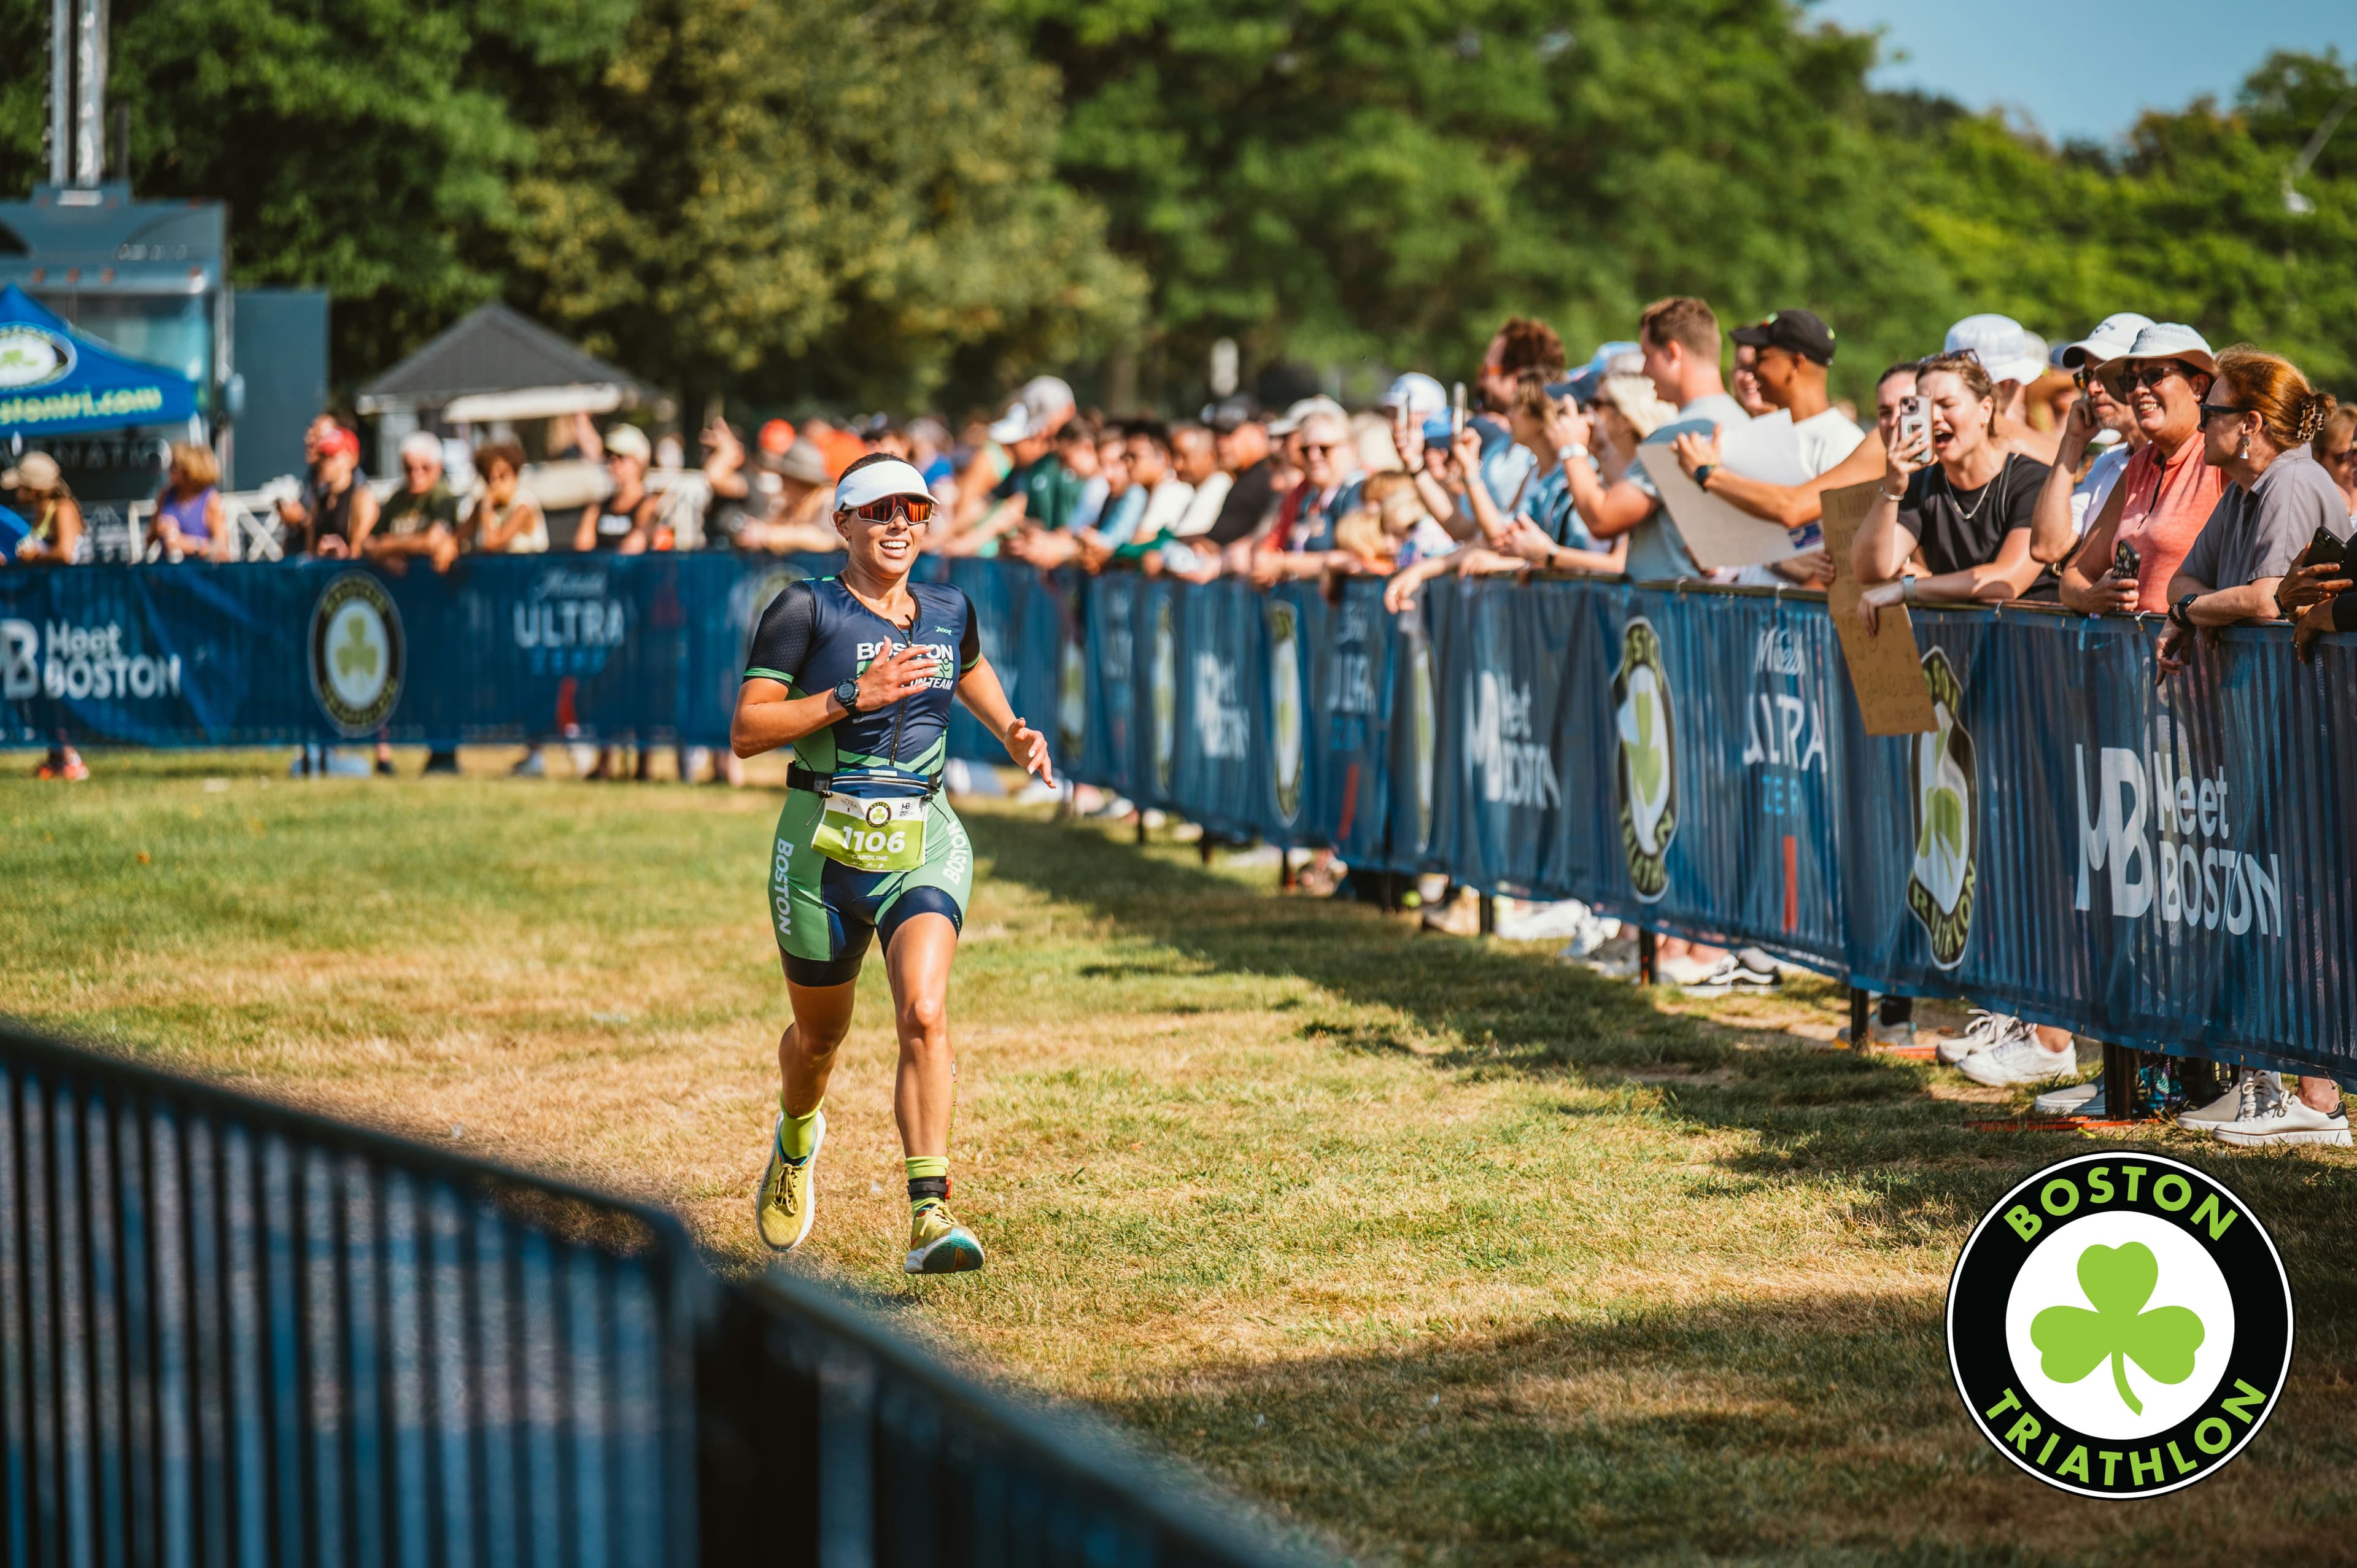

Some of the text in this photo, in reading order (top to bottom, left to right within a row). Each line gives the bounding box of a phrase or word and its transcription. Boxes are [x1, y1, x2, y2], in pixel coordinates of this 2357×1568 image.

[45, 617, 123, 662] Meet
[514, 599, 625, 648] ULTRA
[44, 653, 182, 700] BOSTON
[928, 677, 954, 690] TEAM
[1762, 774, 1801, 816] ZER
[2153, 751, 2230, 840] Meet
[843, 825, 906, 854] 1106
[942, 821, 968, 885] BOSTON
[774, 838, 794, 935] BOSTON
[2159, 840, 2282, 938] BOSTON
